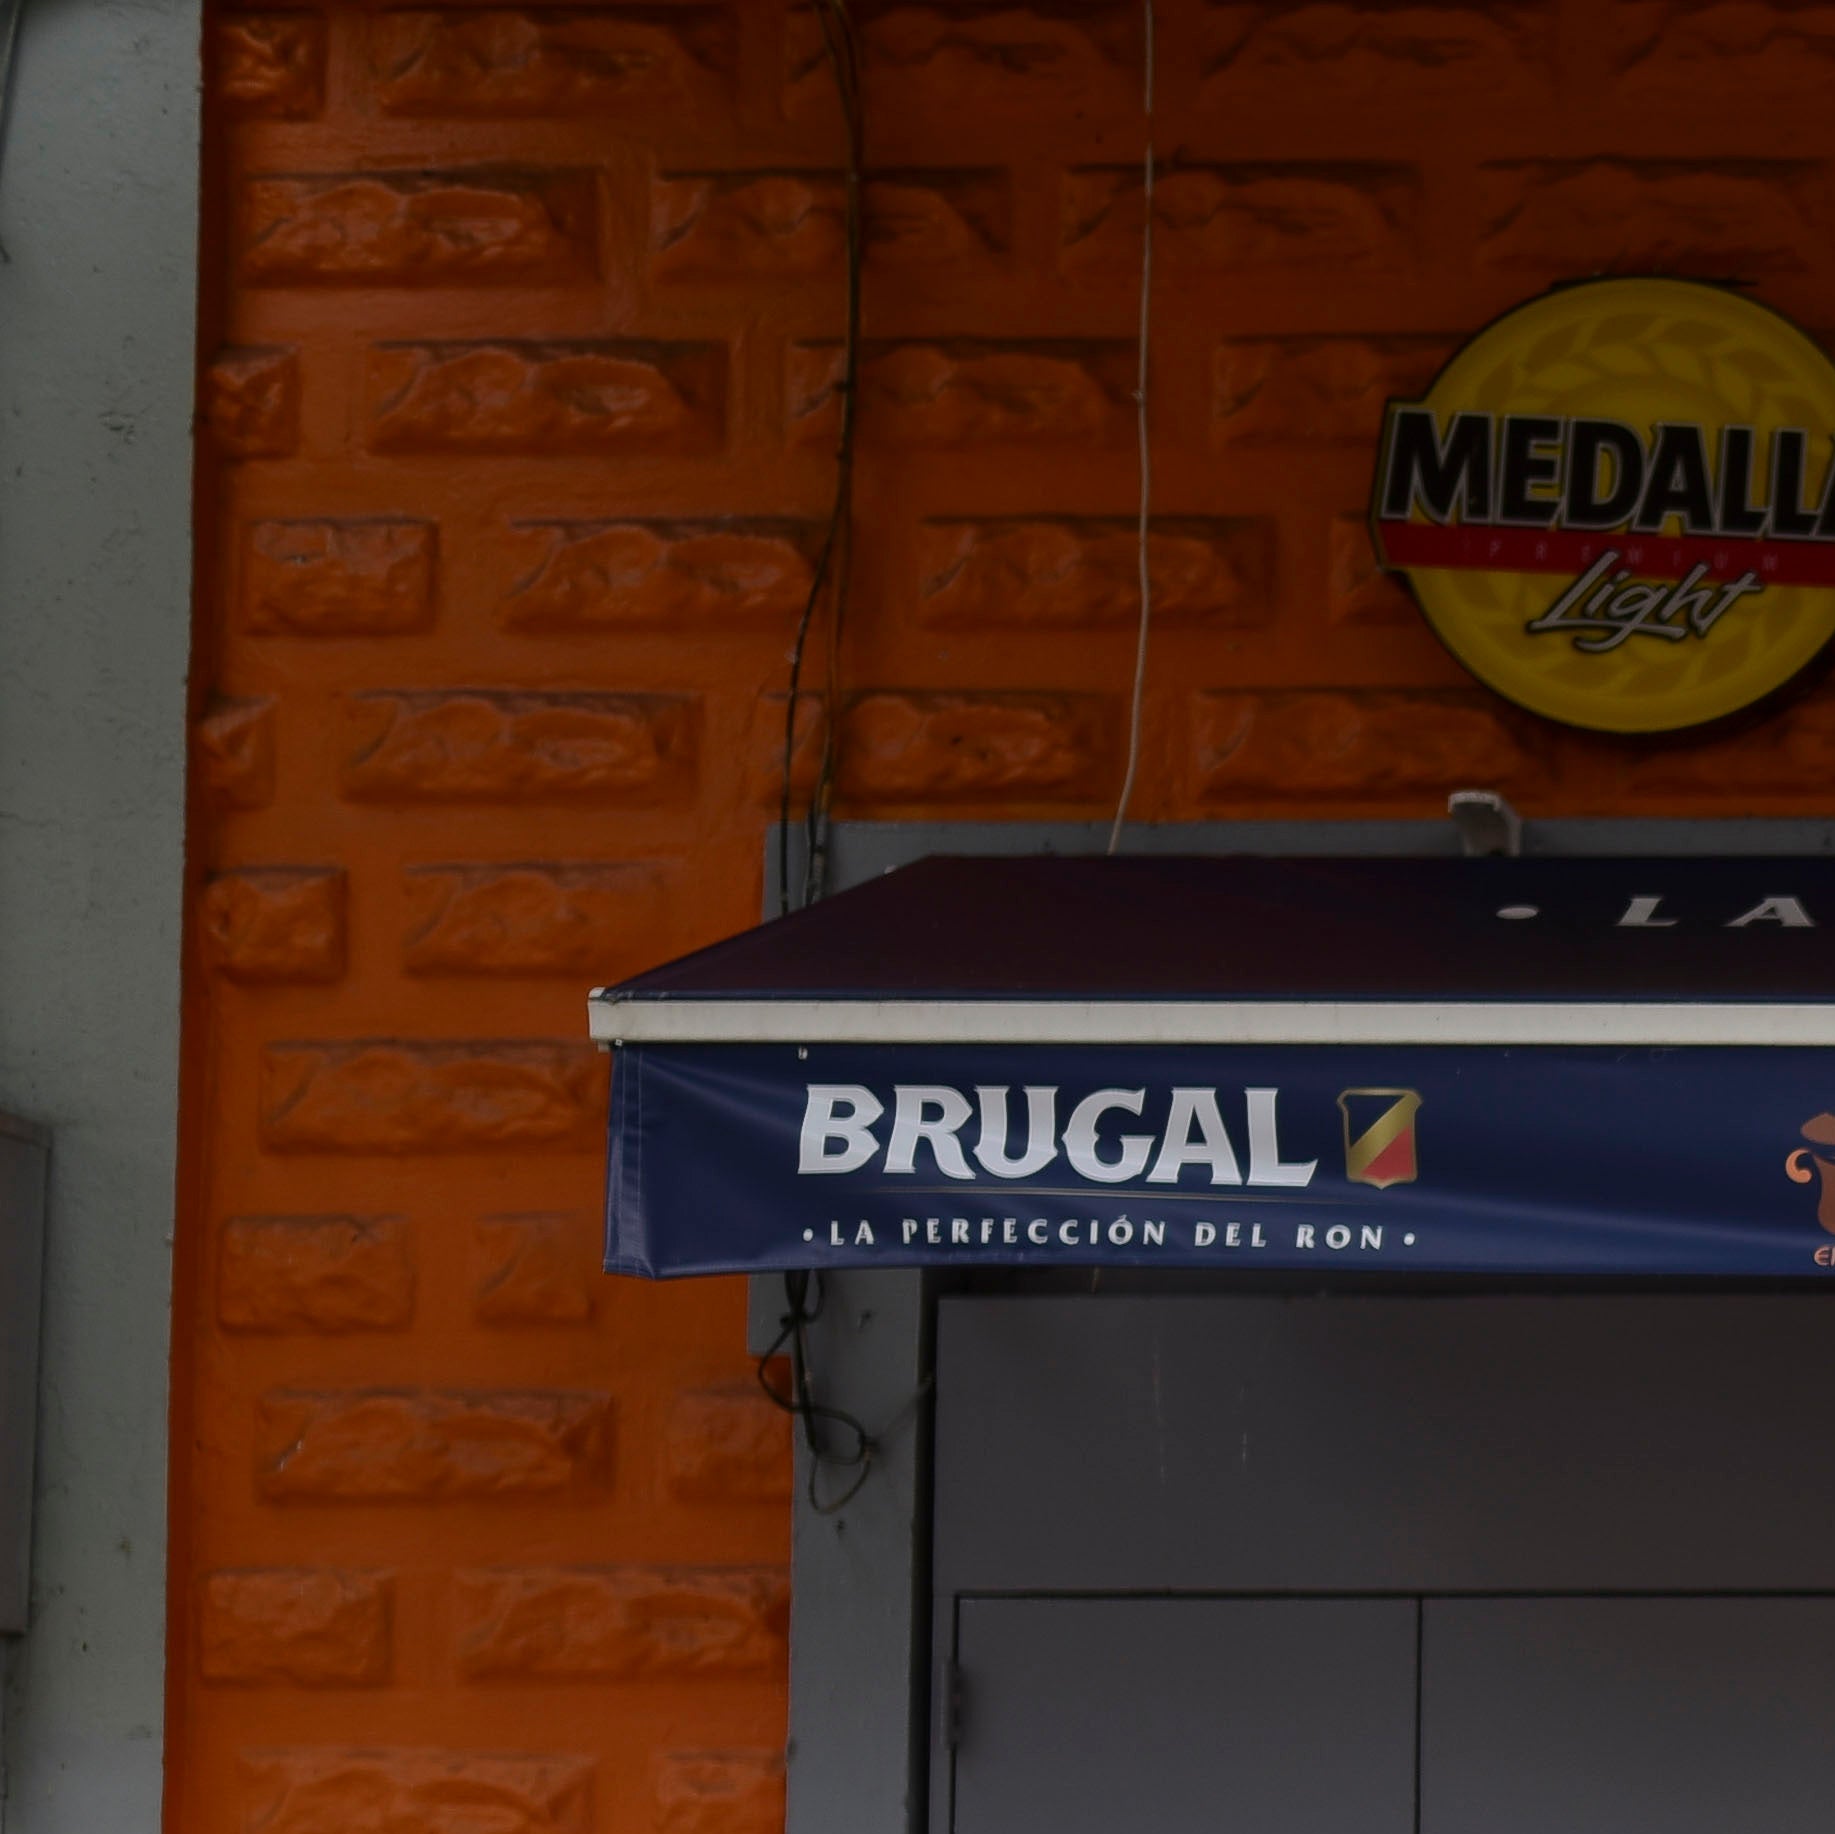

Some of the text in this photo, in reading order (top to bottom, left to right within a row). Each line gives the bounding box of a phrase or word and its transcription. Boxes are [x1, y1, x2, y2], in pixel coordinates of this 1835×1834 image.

[1527, 550, 1765, 652] Light
[1617, 895, 1815, 928] LA
[797, 1084, 1318, 1188] BRUGAL
[830, 1214, 1383, 1251] LA PERFECCIÓN DEL RON
